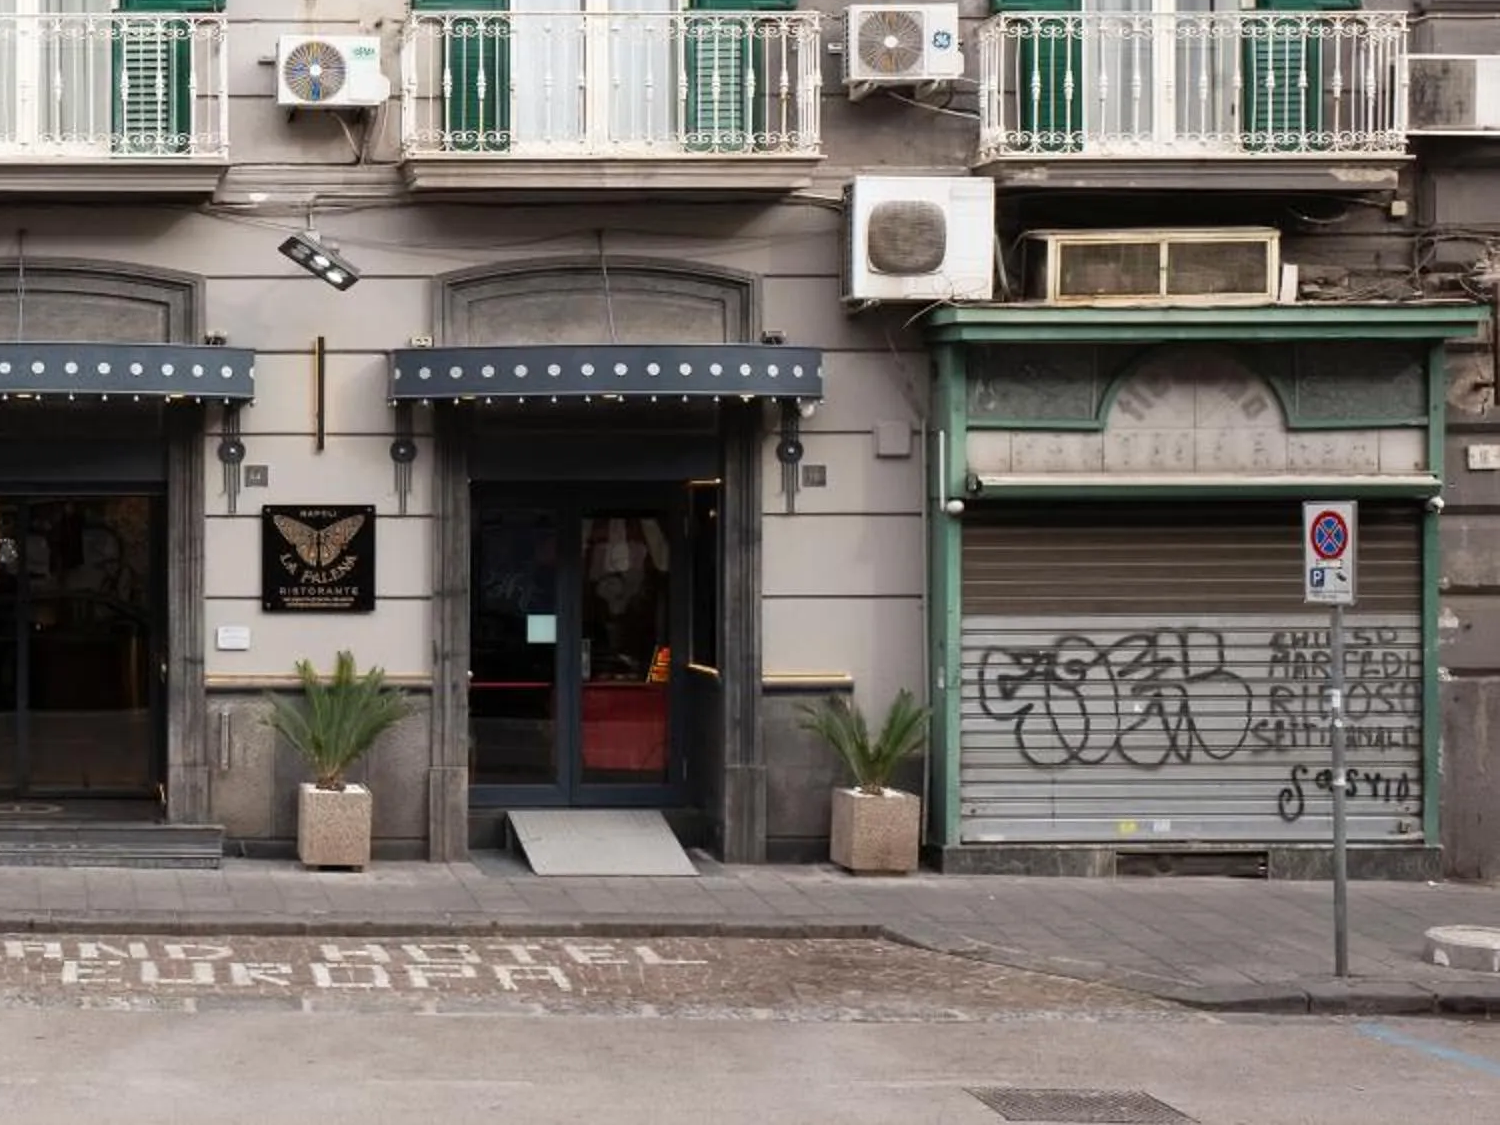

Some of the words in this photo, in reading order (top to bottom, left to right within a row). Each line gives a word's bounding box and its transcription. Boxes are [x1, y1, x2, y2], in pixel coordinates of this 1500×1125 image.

[1313, 570, 1323, 585] P
[279, 586, 360, 595] RISTORANTE
[320, 943, 709, 965] HOTEL
[62, 959, 572, 991] EUROPA
